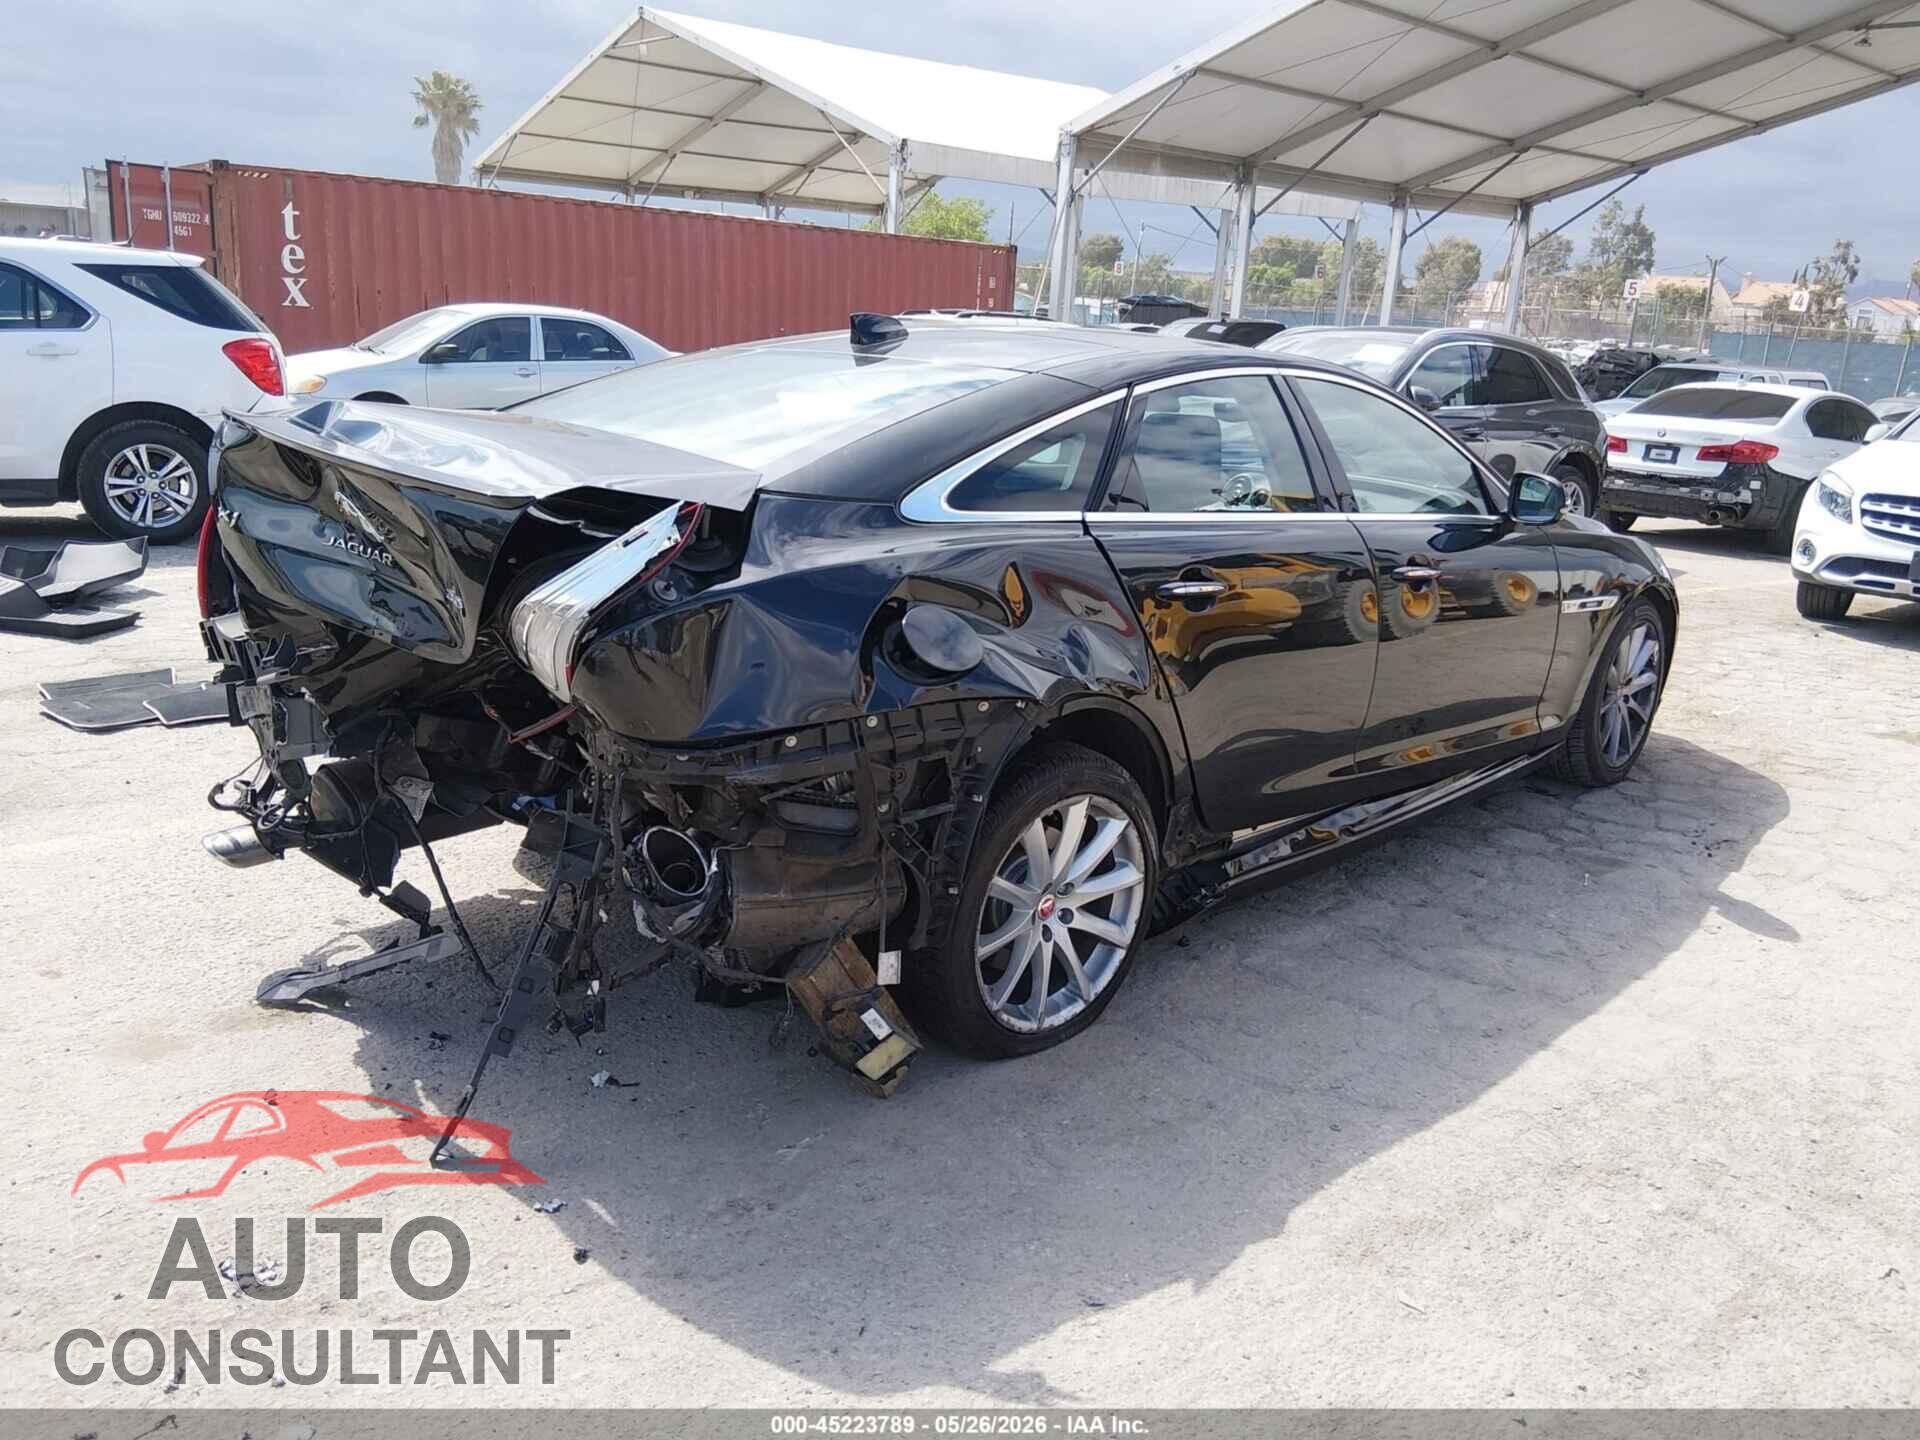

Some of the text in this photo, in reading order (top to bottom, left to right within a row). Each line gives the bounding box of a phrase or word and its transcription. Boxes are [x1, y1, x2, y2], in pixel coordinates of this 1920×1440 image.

[281, 201, 309, 307] tex
[1628, 281, 1638, 296] 5
[320, 536, 393, 567] JAGUAR
